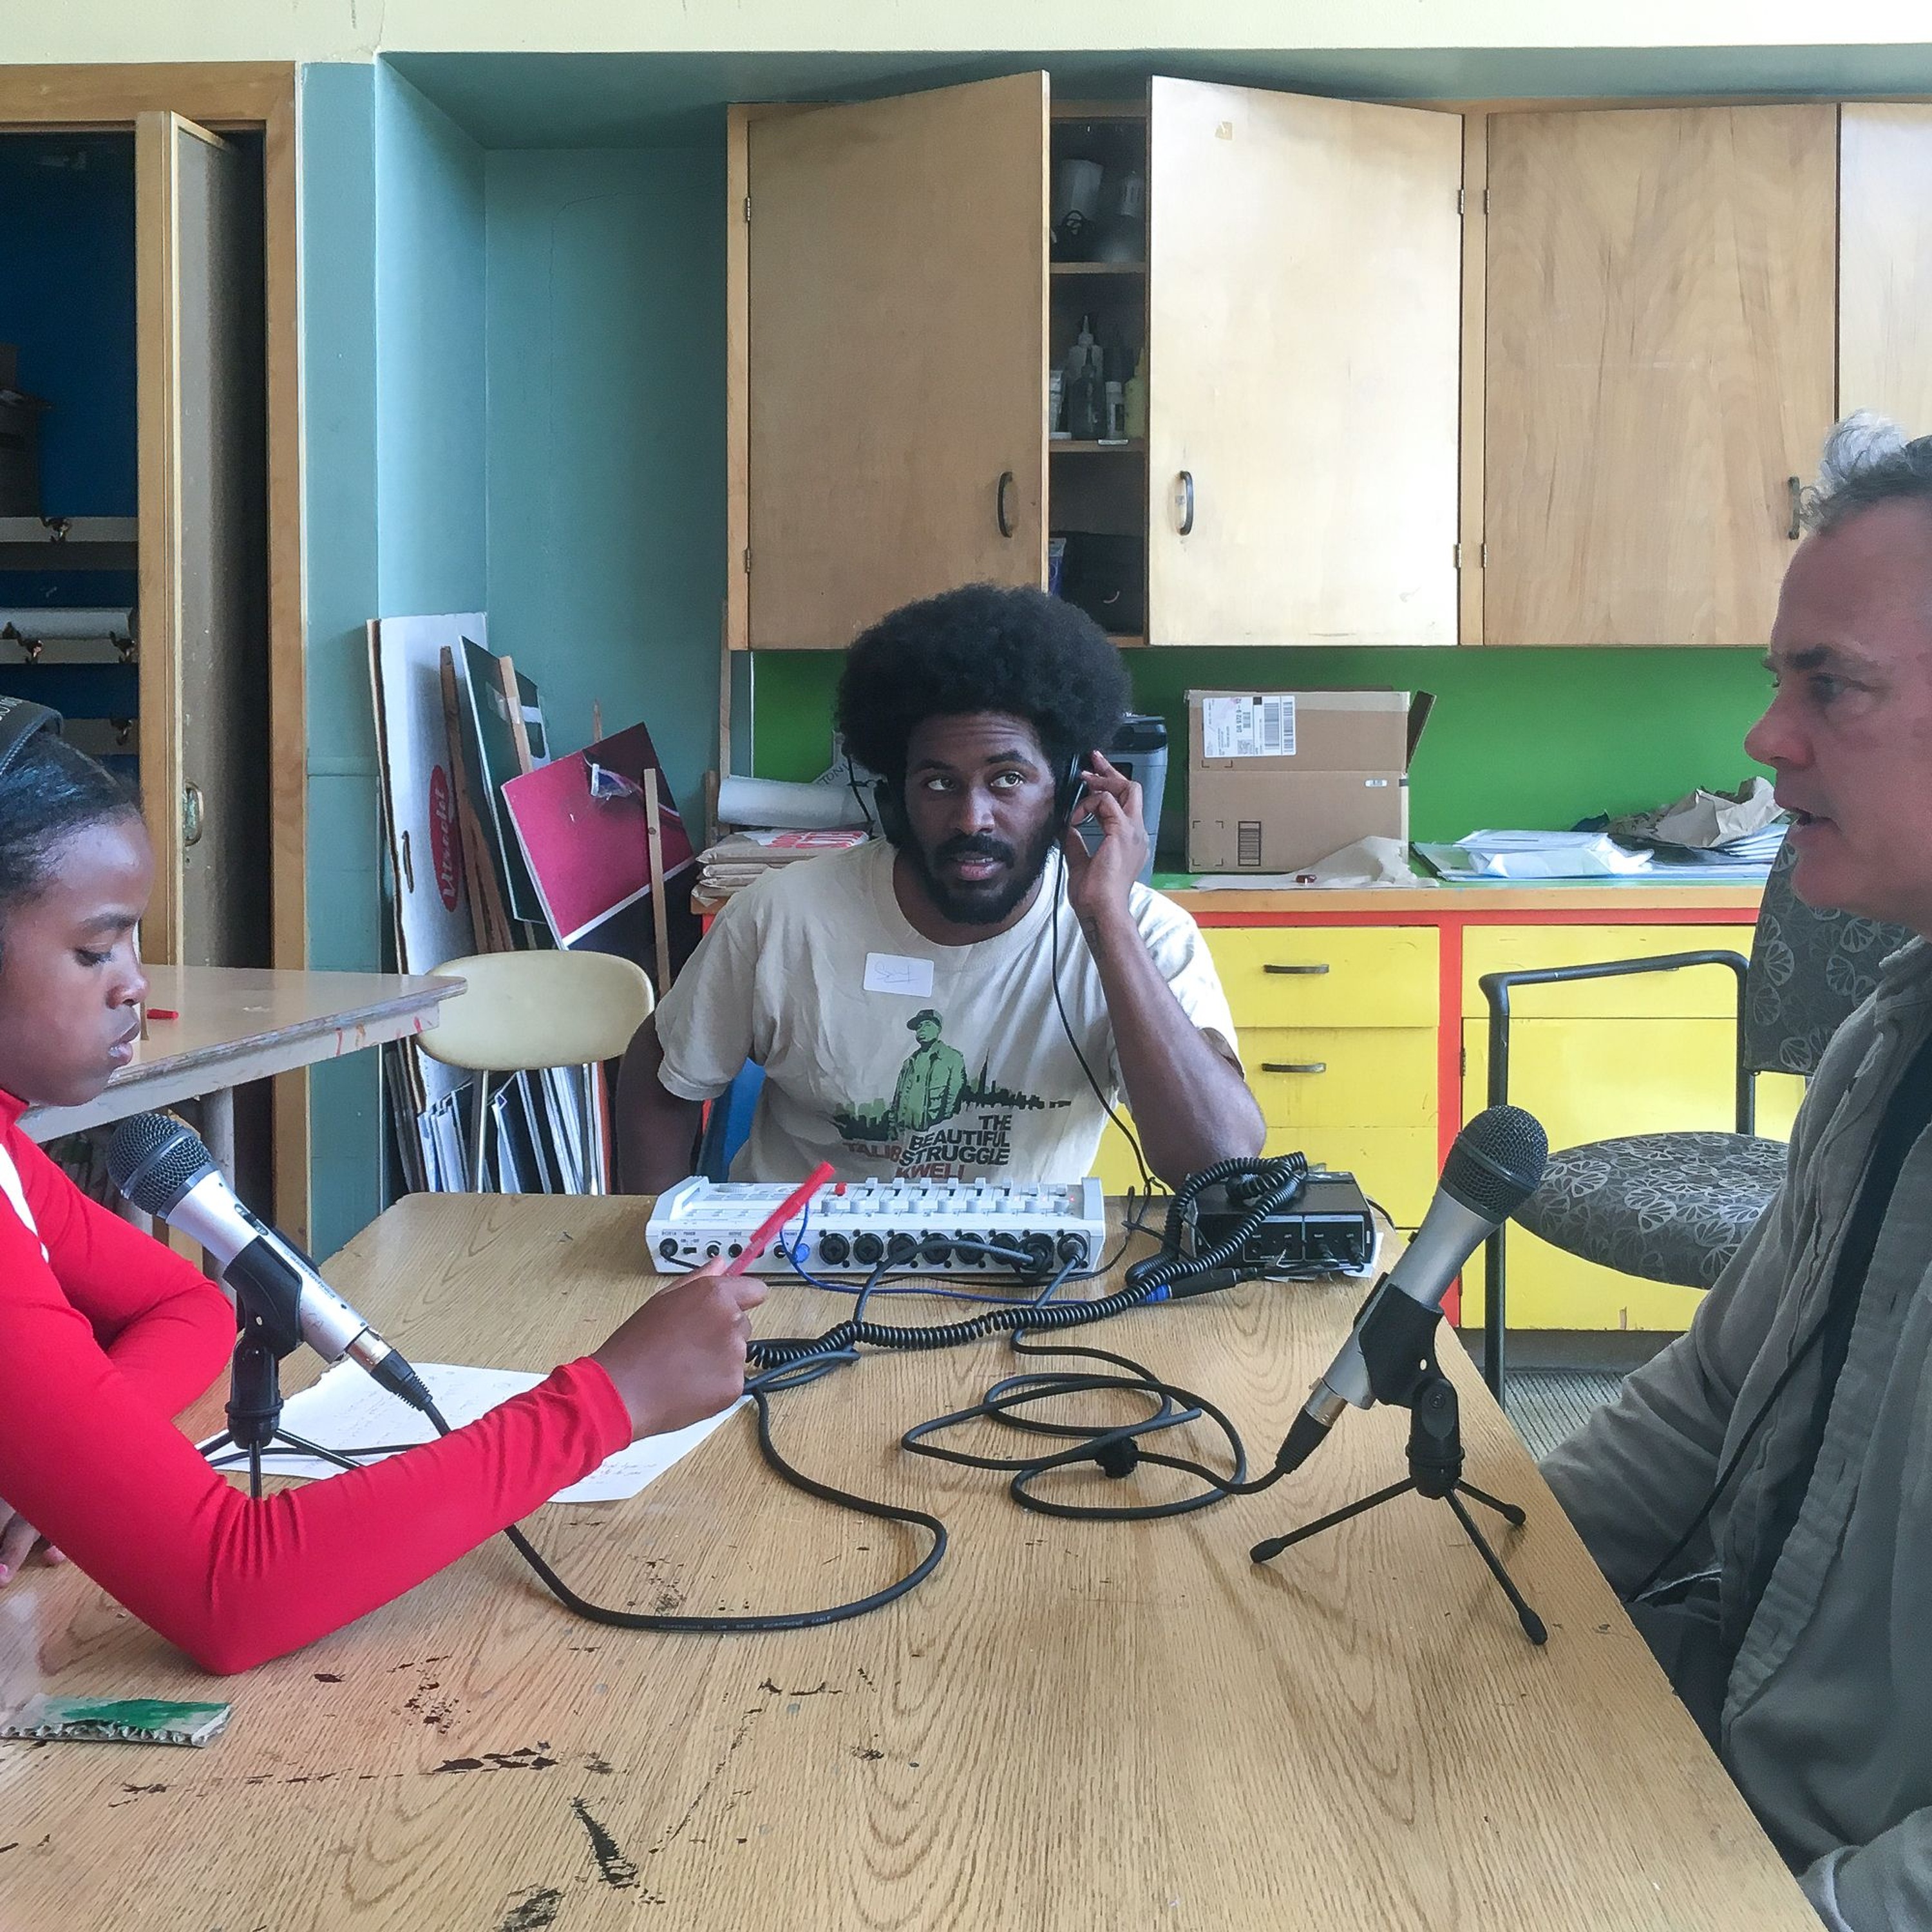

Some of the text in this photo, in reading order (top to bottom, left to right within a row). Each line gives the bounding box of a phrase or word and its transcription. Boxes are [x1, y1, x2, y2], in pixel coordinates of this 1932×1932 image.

[978, 1114, 1012, 1131] THE
[909, 1128, 1010, 1151] BEAUTIFUL
[842, 1142, 902, 1162] TALIB
[899, 1145, 1011, 1167] STRUGGLE
[894, 1162, 965, 1180] KWELI
